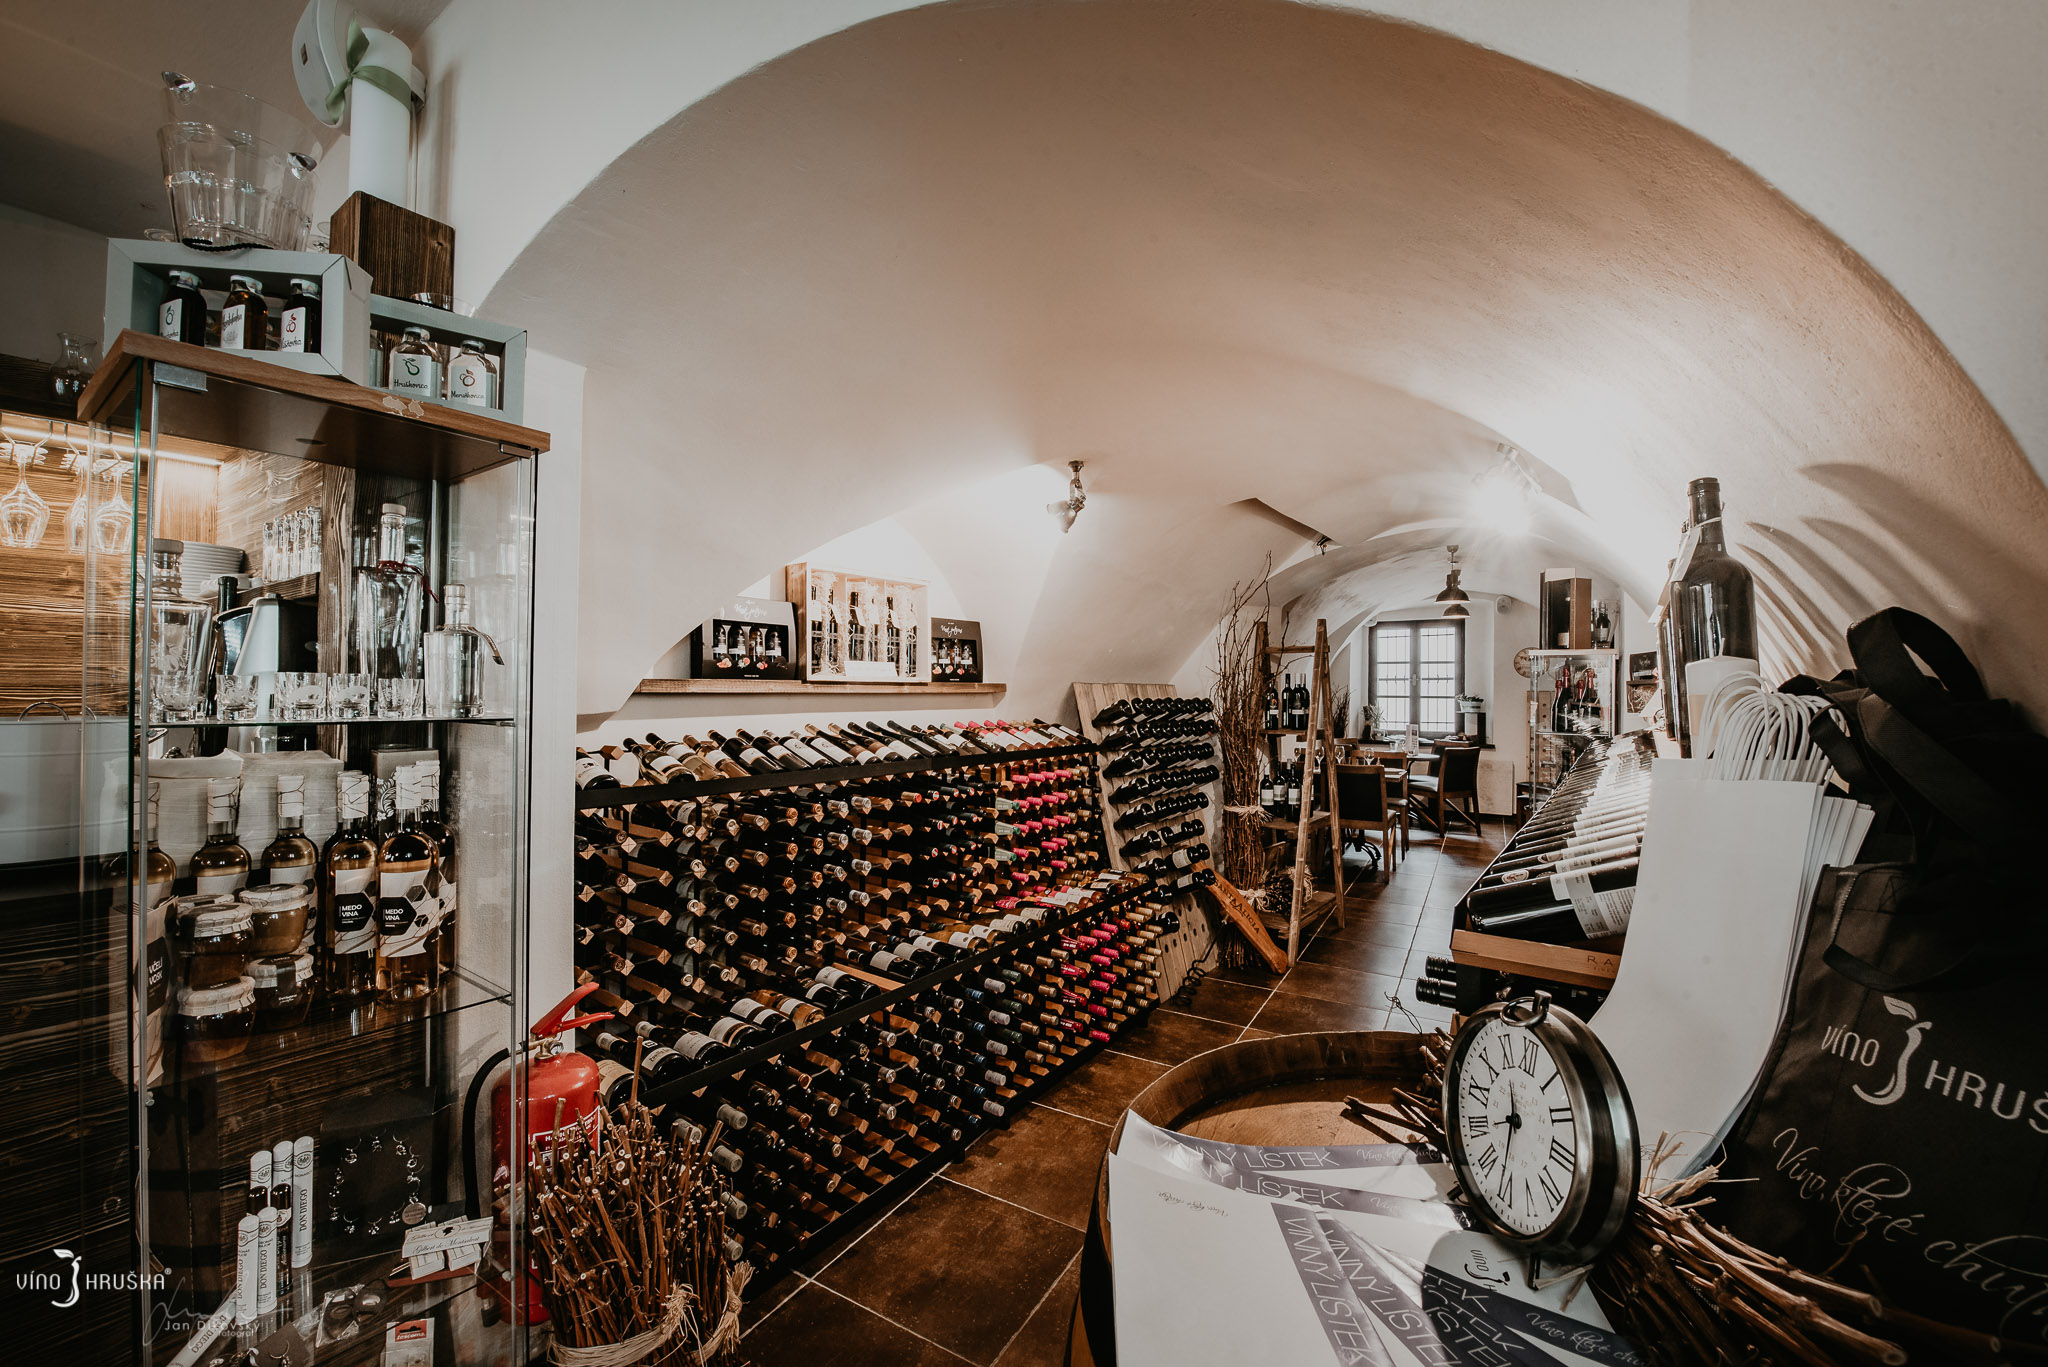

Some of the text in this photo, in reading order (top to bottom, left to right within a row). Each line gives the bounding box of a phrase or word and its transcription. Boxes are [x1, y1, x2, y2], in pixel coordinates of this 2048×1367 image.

[341, 904, 363, 912] MEDO
[1518, 1035, 1539, 1078] XII
[1468, 1115, 1490, 1139] VIII
[1549, 1106, 1574, 1126] II
[1243, 1149, 1340, 1168] LÍSTEK
[1478, 1142, 1499, 1179] VII
[1549, 1136, 1575, 1174] III
[300, 1188, 308, 1213] DIEGO
[1239, 1174, 1344, 1207] LÍSTEK
[300, 1213, 308, 1232] DON
[259, 1249, 268, 1273] DIEGO
[1284, 1218, 1343, 1282] VINNÝ
[259, 1273, 267, 1289] DON
